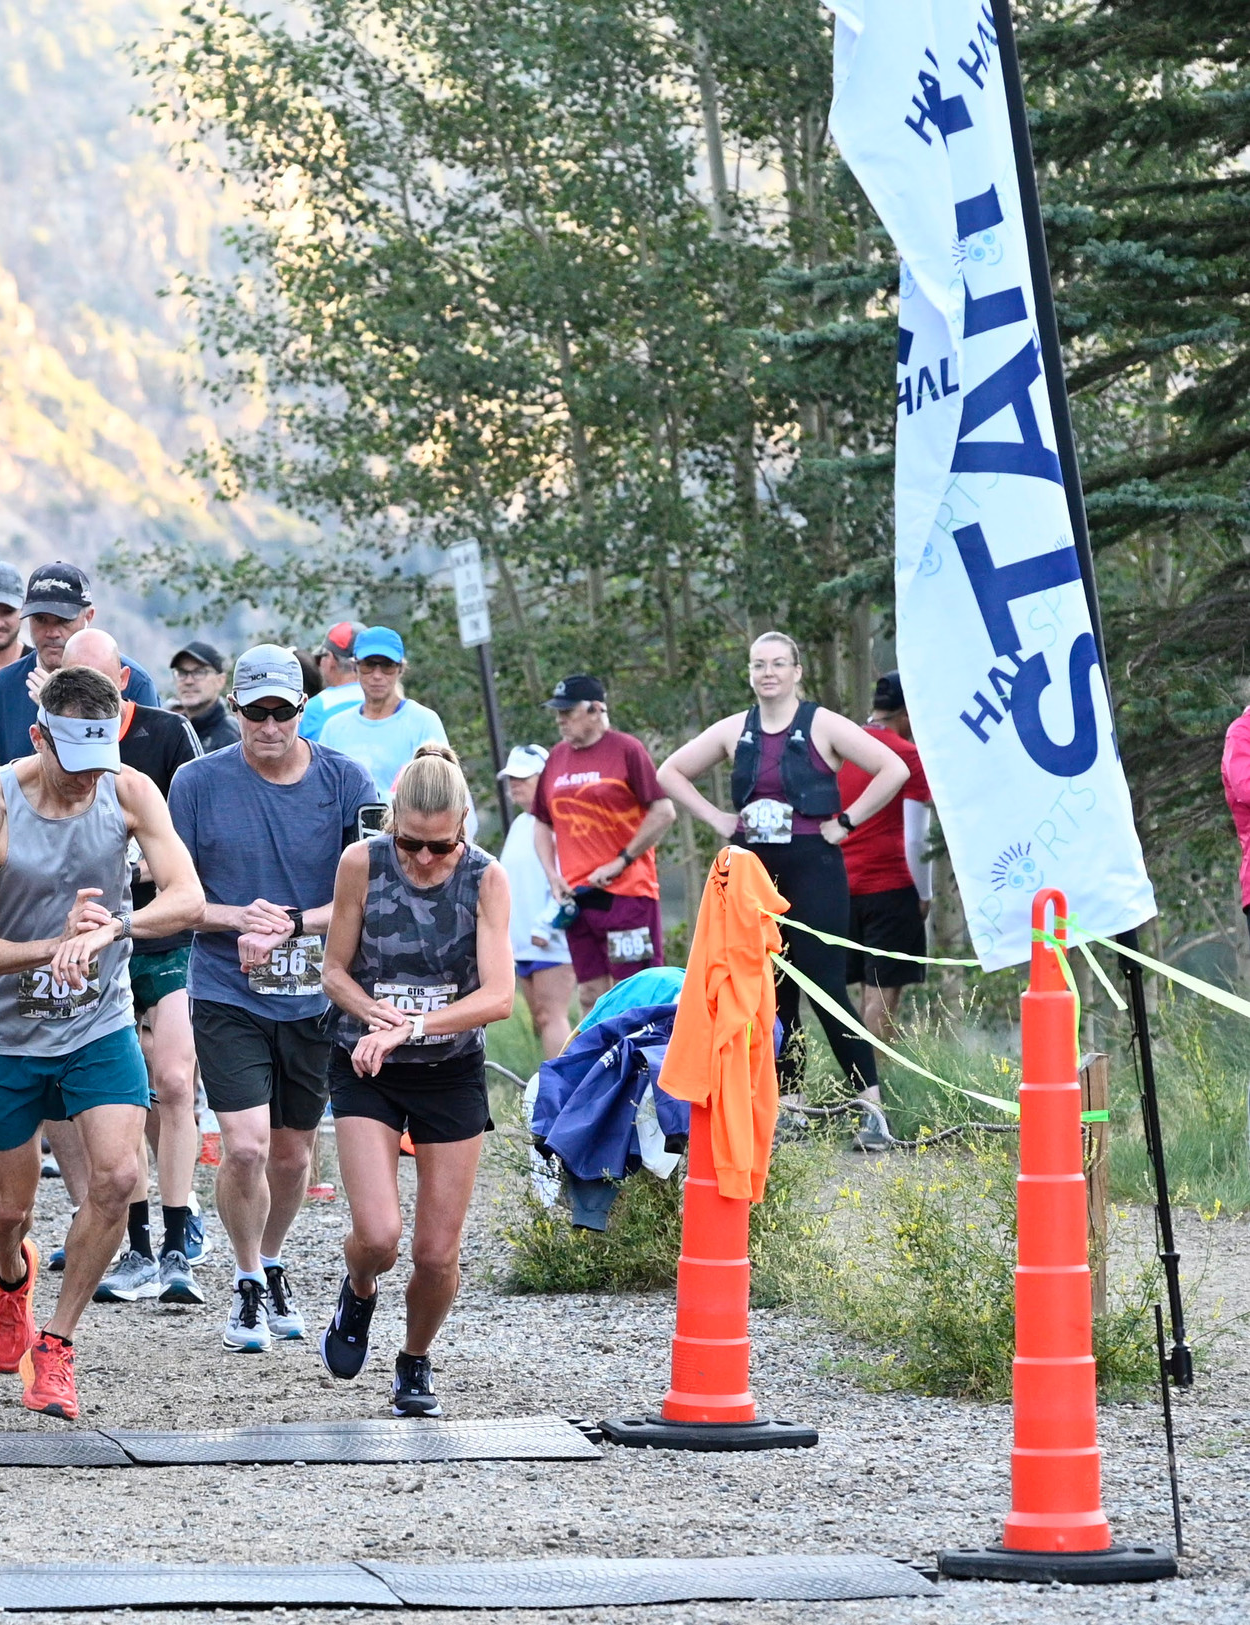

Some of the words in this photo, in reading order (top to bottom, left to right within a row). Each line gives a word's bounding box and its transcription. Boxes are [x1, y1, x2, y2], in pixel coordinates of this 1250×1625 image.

[904, 46, 940, 146] HA
[282, 940, 298, 948] GTIS
[612, 936, 645, 958] 769
[271, 948, 307, 976] 56
[407, 987, 426, 996] GTIS
